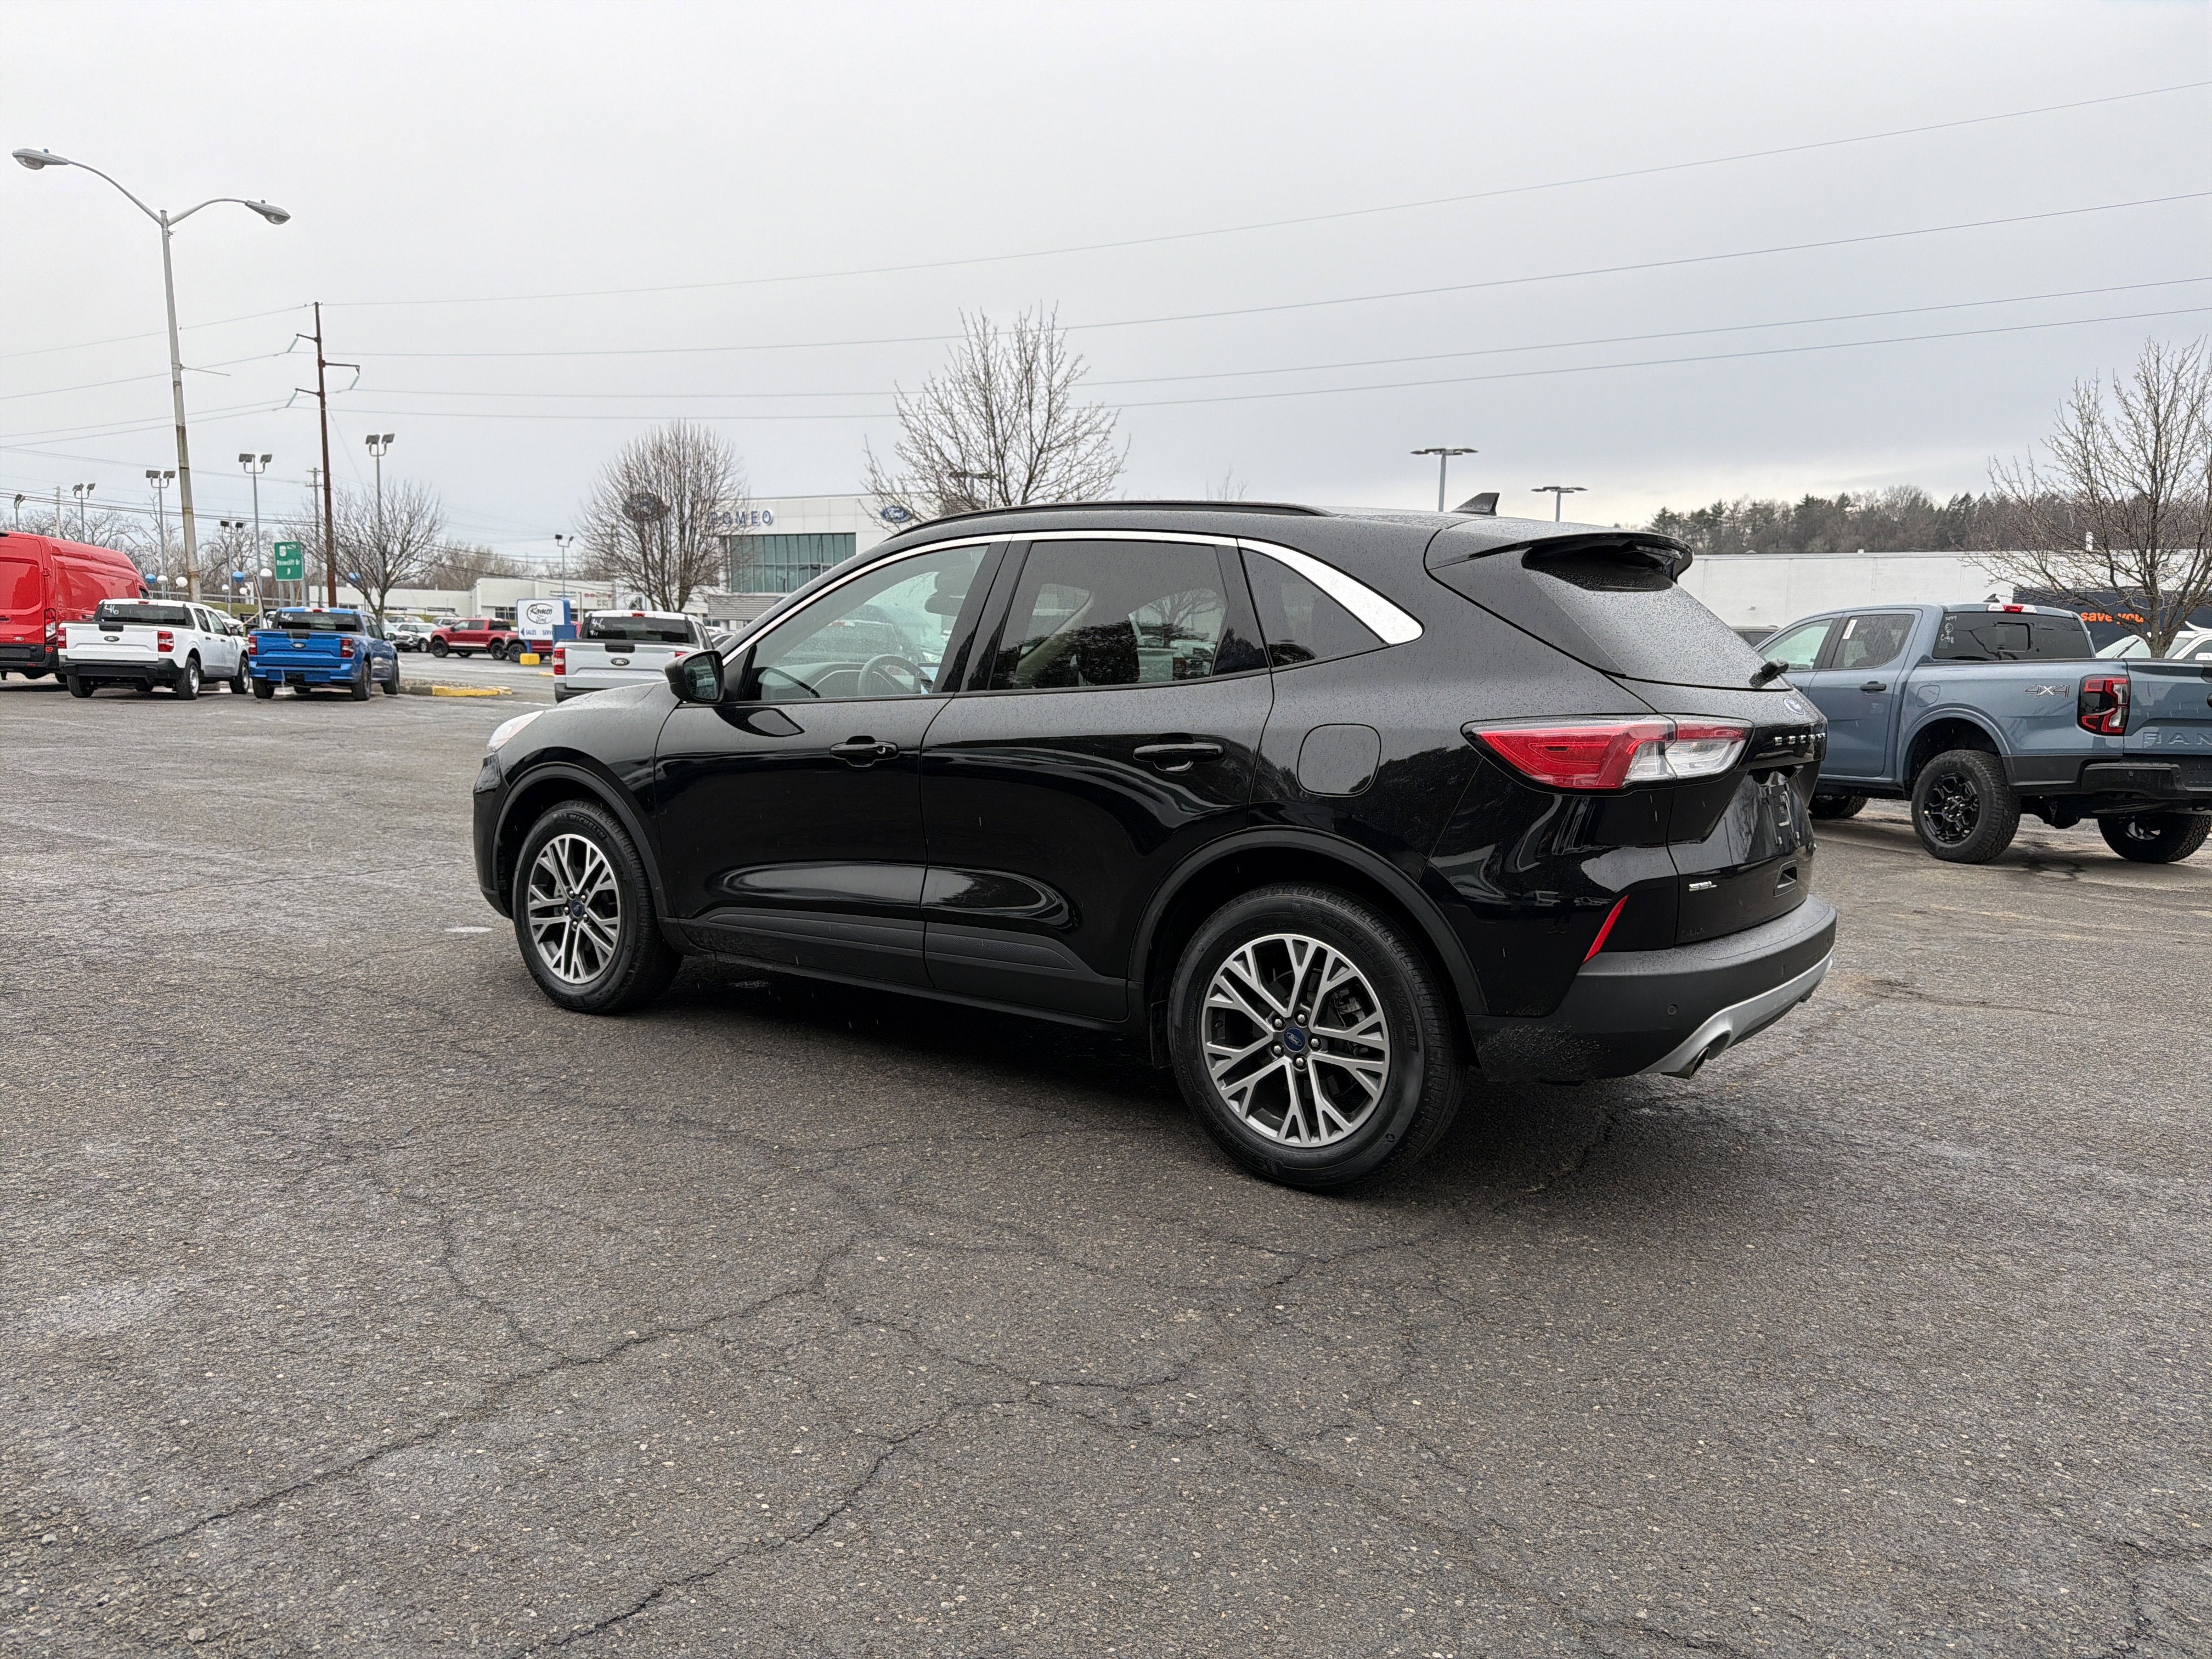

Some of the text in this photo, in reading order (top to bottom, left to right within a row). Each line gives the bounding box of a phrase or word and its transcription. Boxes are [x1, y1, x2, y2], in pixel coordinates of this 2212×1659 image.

[710, 510, 772, 525] ROMEO
[104, 605, 119, 615] 46
[530, 604, 553, 616] Romeo
[2081, 612, 2113, 622] save
[592, 618, 606, 629] 46
